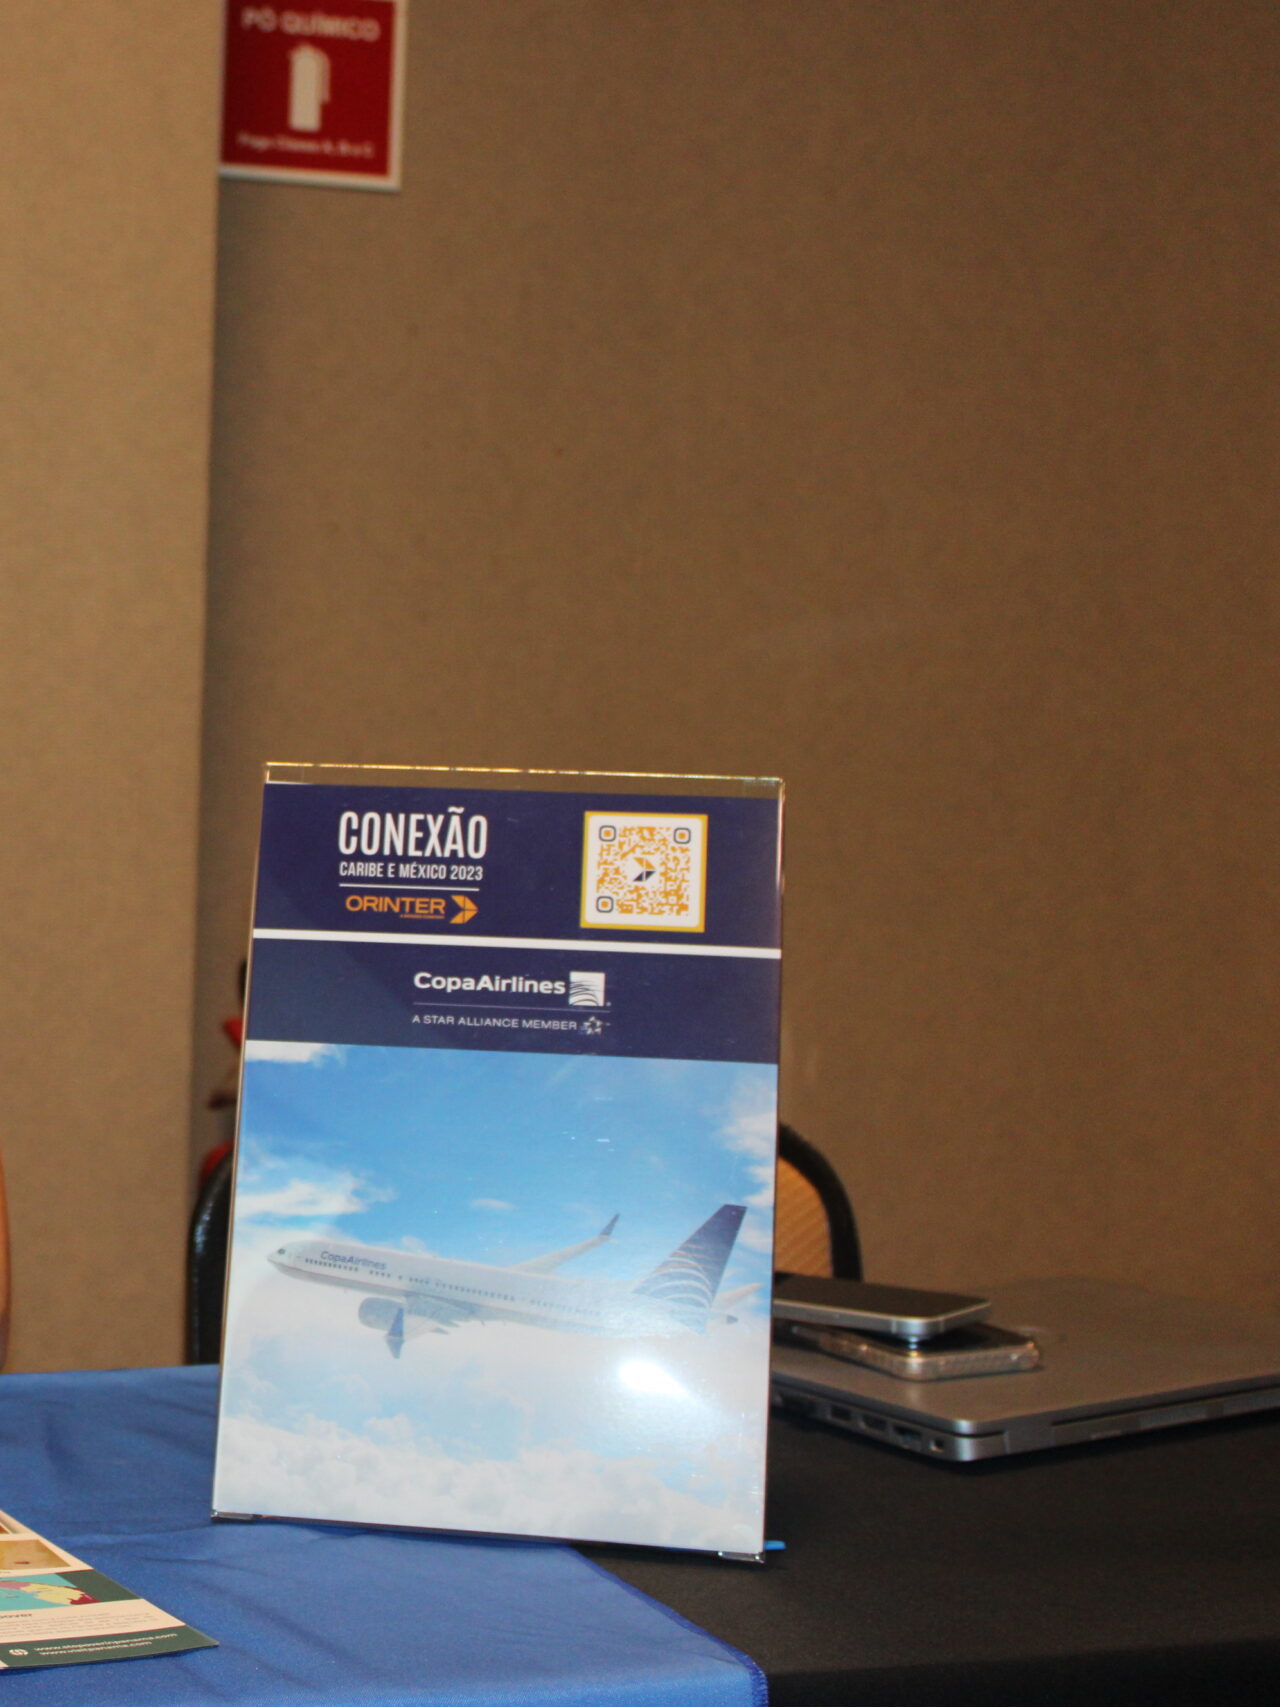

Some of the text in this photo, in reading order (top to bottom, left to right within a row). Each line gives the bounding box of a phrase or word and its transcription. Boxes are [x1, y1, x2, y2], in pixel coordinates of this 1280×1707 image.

[338, 806, 488, 860] CONEXÃO
[338, 861, 484, 881] CARIBE E MÉXICO 2023
[345, 895, 446, 915] ORINTER
[413, 971, 566, 995] CopaAirlines
[411, 1014, 577, 1030] A STAR ALLIANCE MEMBER
